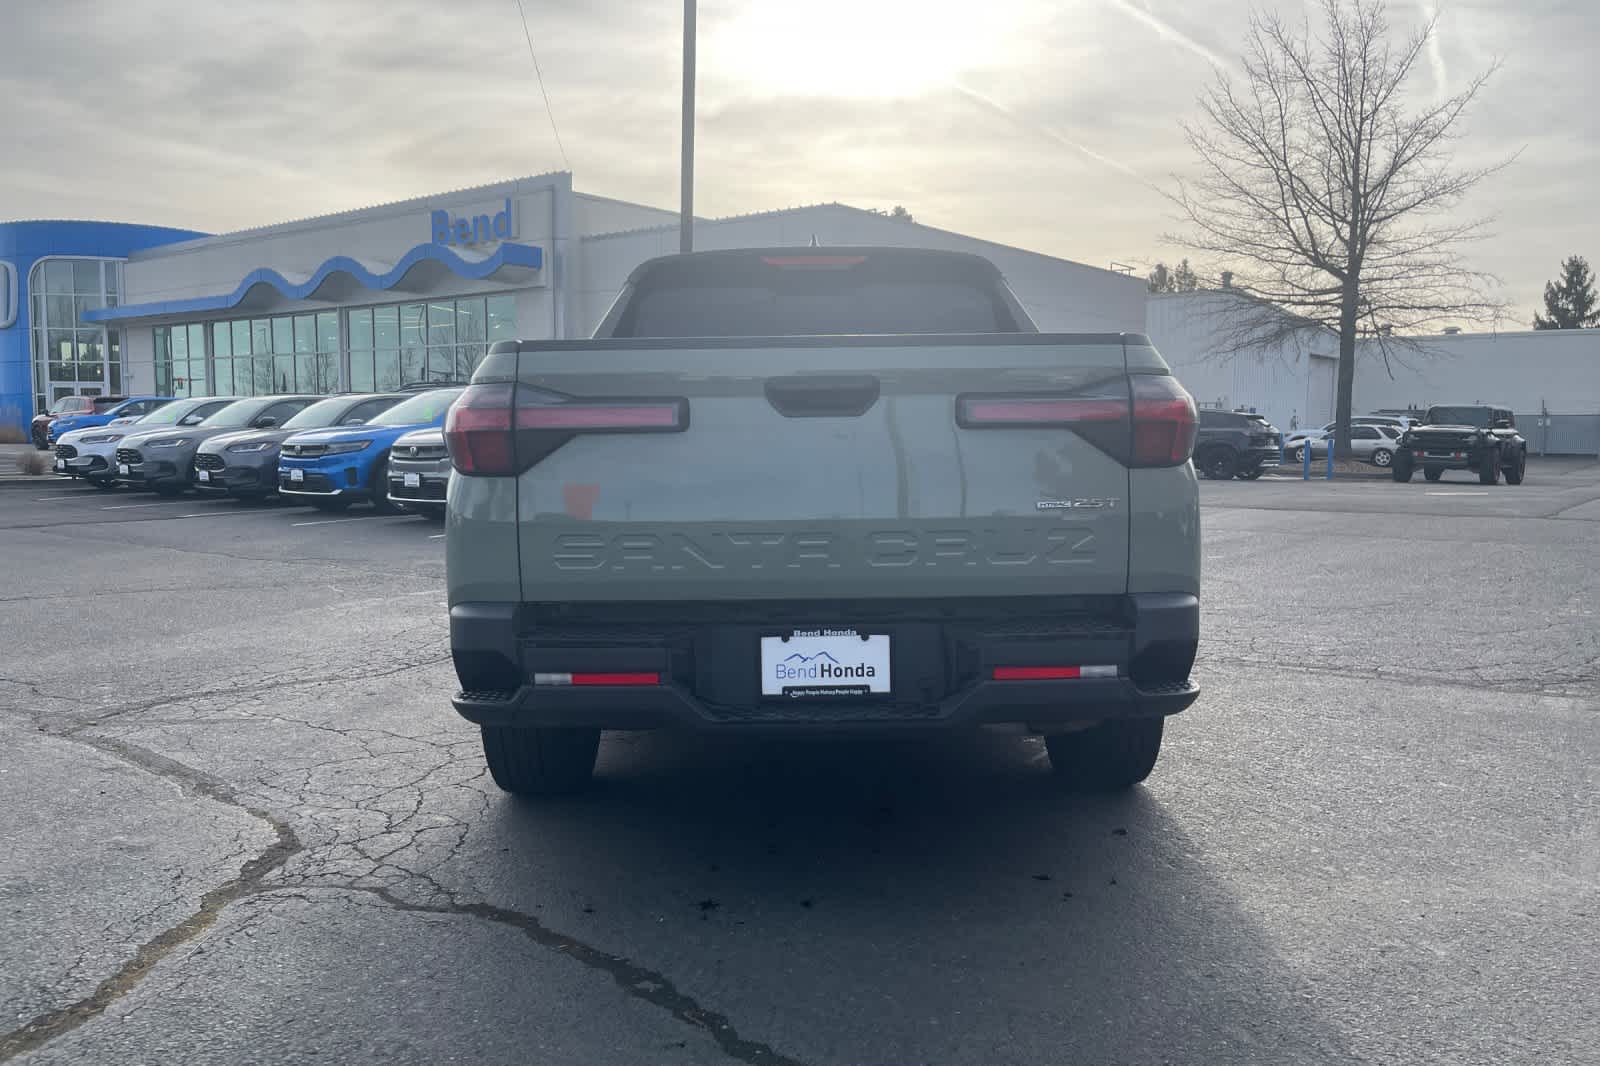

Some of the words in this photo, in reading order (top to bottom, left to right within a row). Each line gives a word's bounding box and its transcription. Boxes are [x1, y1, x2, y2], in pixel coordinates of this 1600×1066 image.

[431, 198, 512, 246] Bend
[552, 531, 840, 570] SANTA
[864, 527, 1096, 568] CRUZ
[793, 629, 821, 637] Bend
[823, 628, 857, 637] Honda
[776, 663, 817, 679] Bend
[820, 662, 876, 678] Honda
